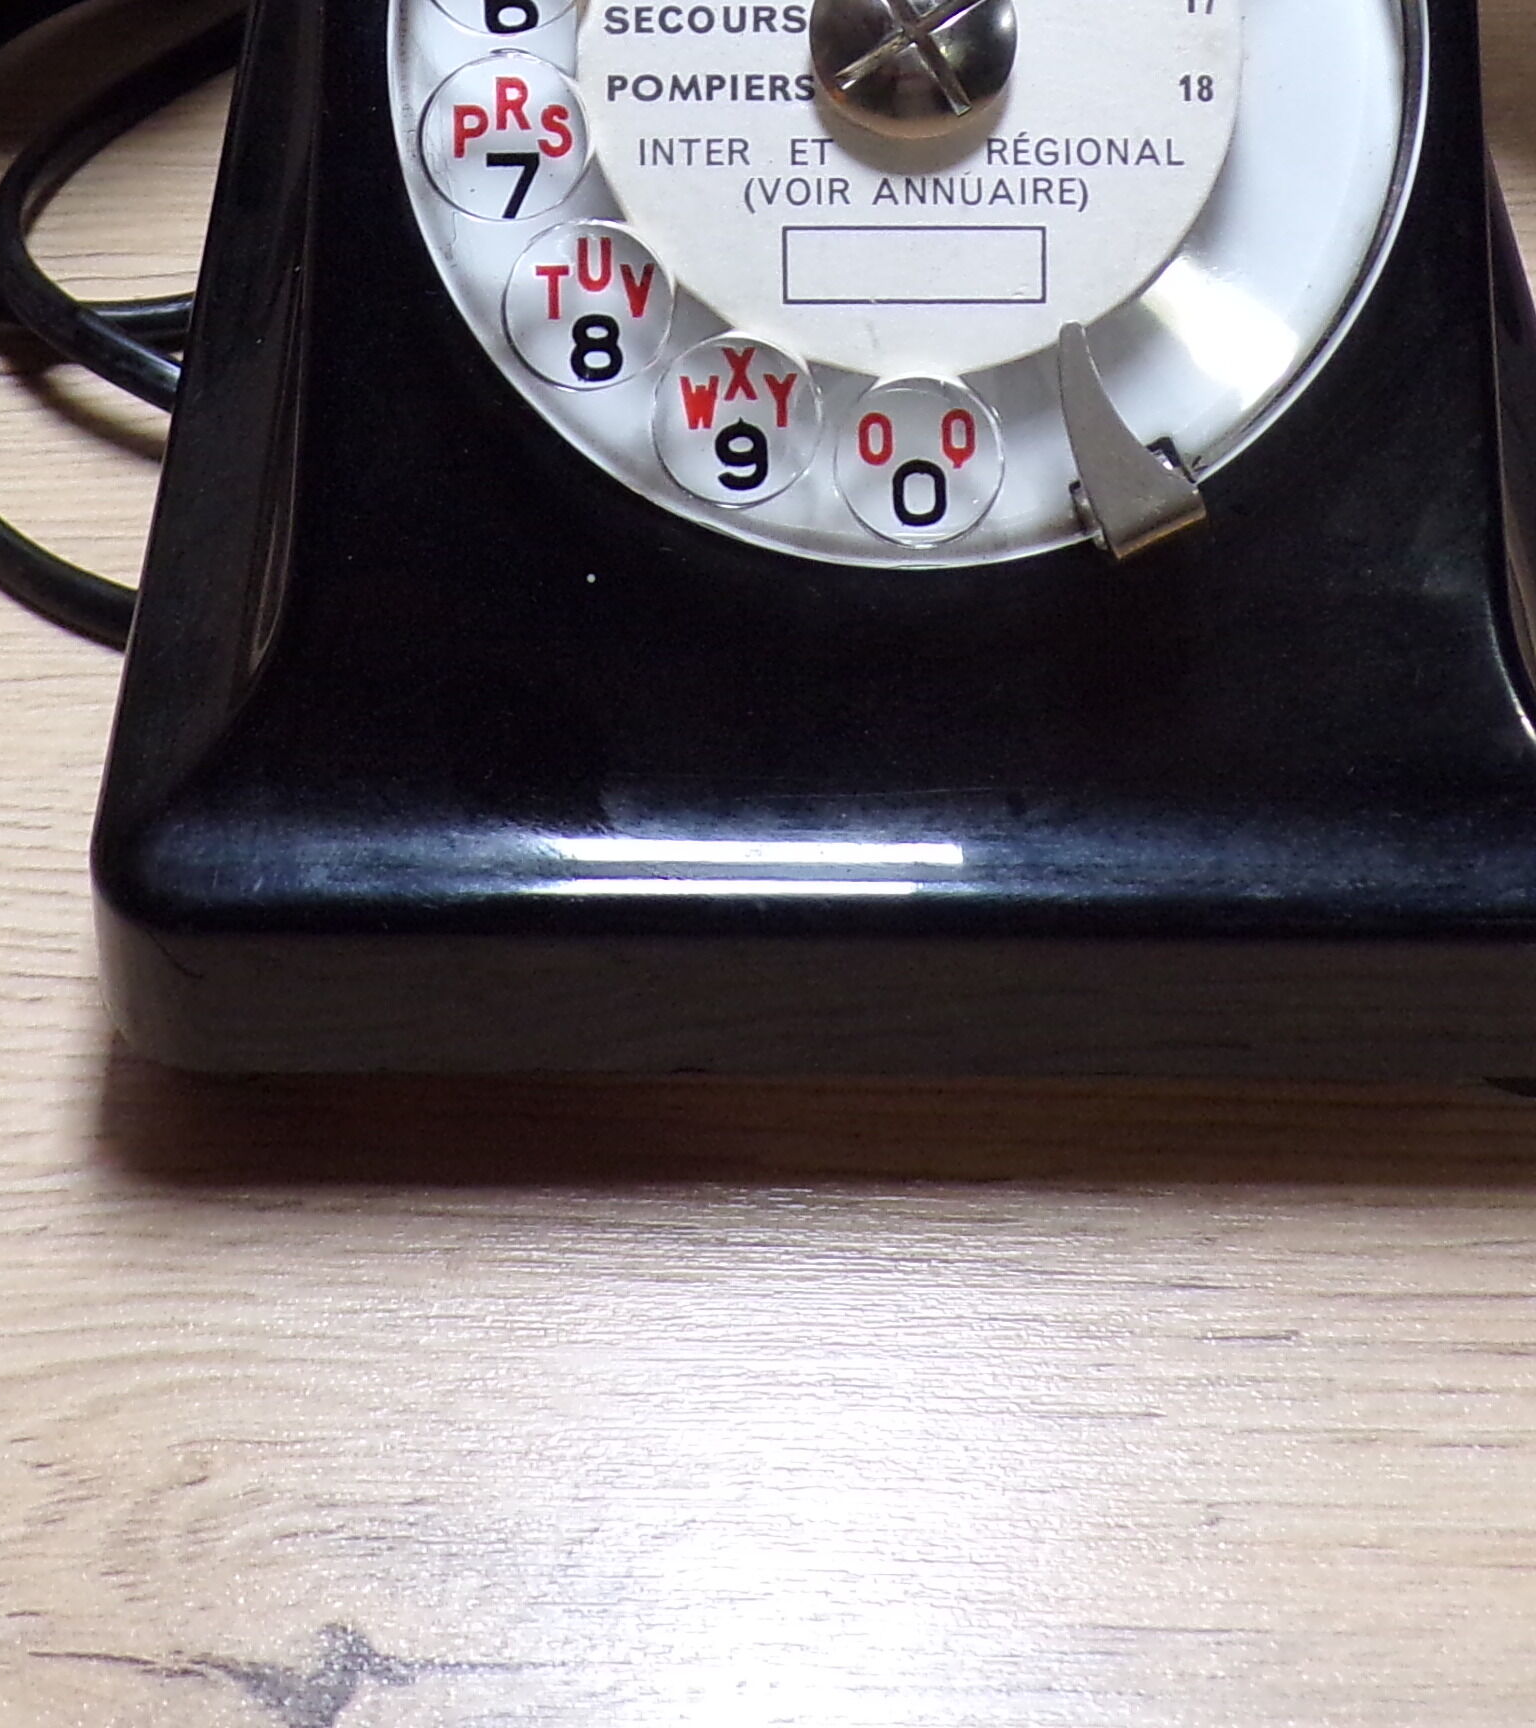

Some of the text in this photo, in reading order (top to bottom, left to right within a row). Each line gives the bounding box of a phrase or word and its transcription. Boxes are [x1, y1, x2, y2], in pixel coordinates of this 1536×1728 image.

[603, 5, 807, 34] SECOURS
[607, 73, 1213, 102] POMPIERS 18
[639, 132, 1185, 167] INTER ET RÉGIONAL
[486, 152, 540, 219] 7
[744, 176, 1089, 213] (VOIR ANNUAIRE)
[570, 313, 624, 382] 8
[714, 416, 768, 491] 9
